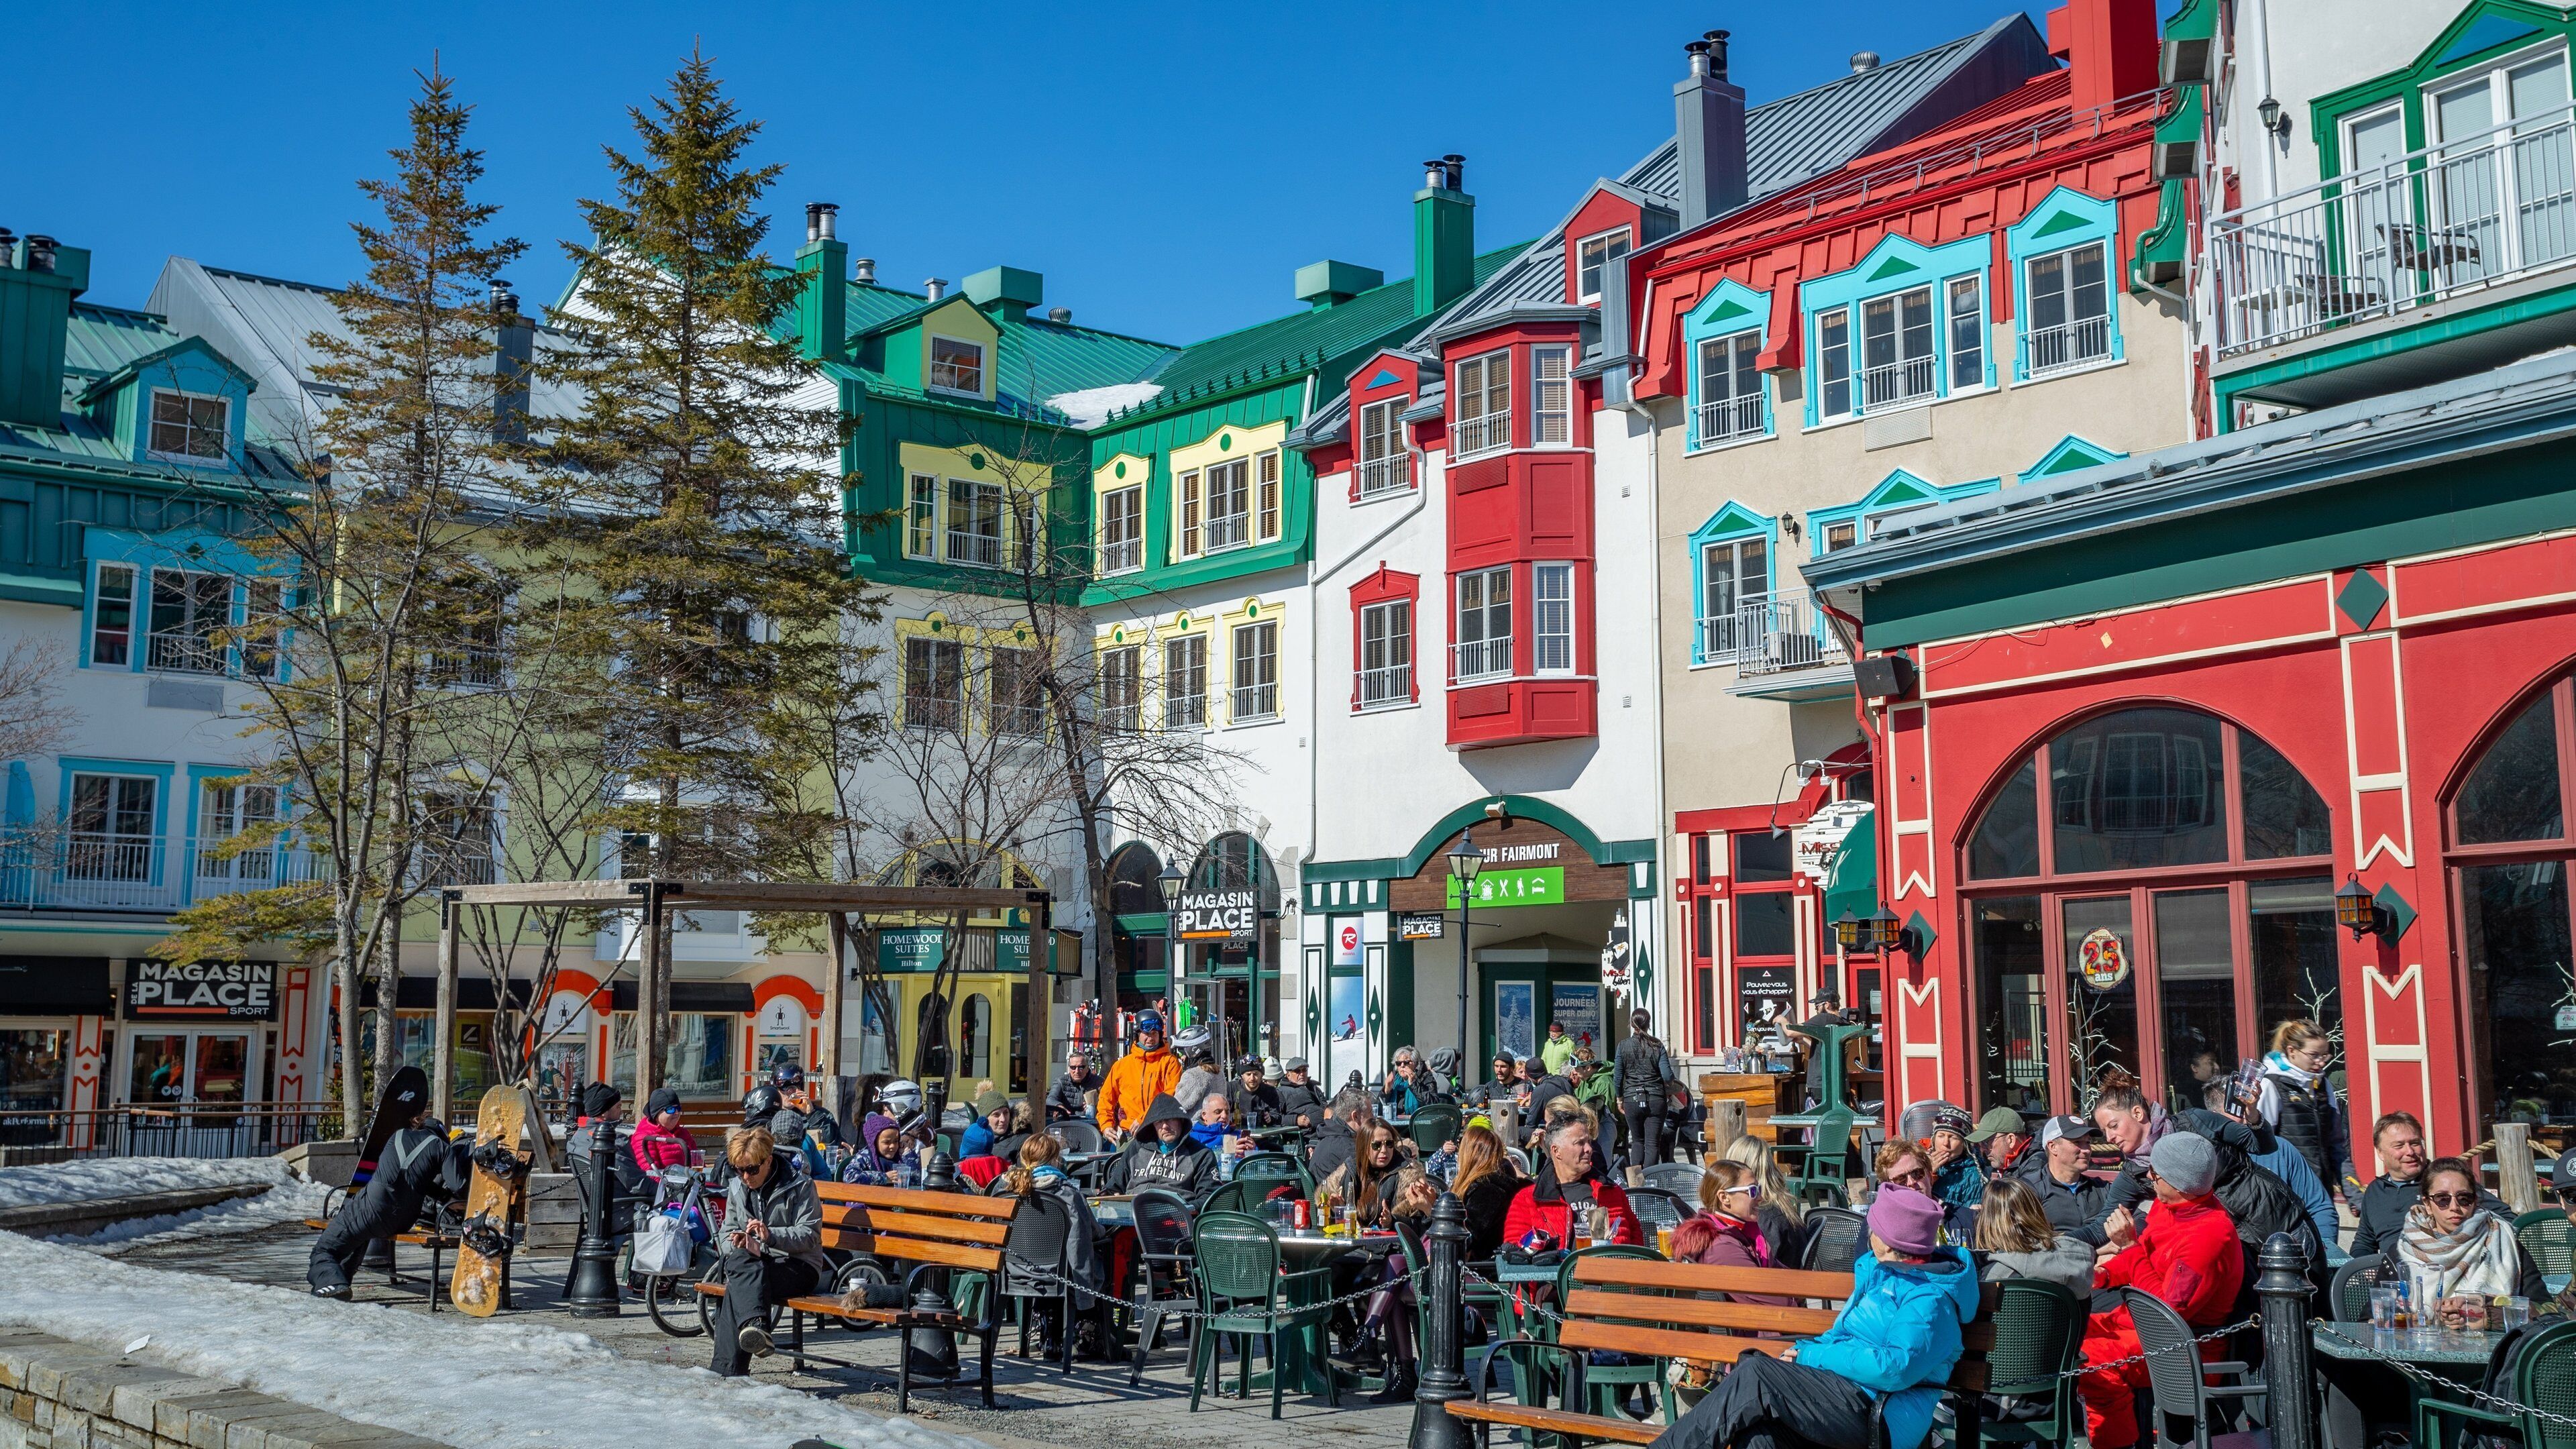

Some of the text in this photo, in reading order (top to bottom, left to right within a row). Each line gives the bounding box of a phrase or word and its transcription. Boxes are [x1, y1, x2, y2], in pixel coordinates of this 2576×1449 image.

[1480, 843, 1560, 863] UR FAIRMONT
[1182, 892, 1253, 910] MAGASIN
[1182, 908, 1253, 930] PLACE
[1403, 916, 1440, 925] MAGASIN
[1404, 923, 1441, 934] PLACE
[1000, 934, 1055, 947] HOMED
[895, 944, 930, 953] SUITES
[1014, 945, 1030, 953] SUI
[2084, 941, 2120, 975] 25
[140, 963, 272, 982] MAGASIN
[2094, 973, 2113, 982] ans
[138, 981, 271, 1006] PLACE
[1554, 997, 1596, 1007] JOURNÉES
[229, 1007, 270, 1015] SPORT
[397, 1090, 415, 1102] K2
